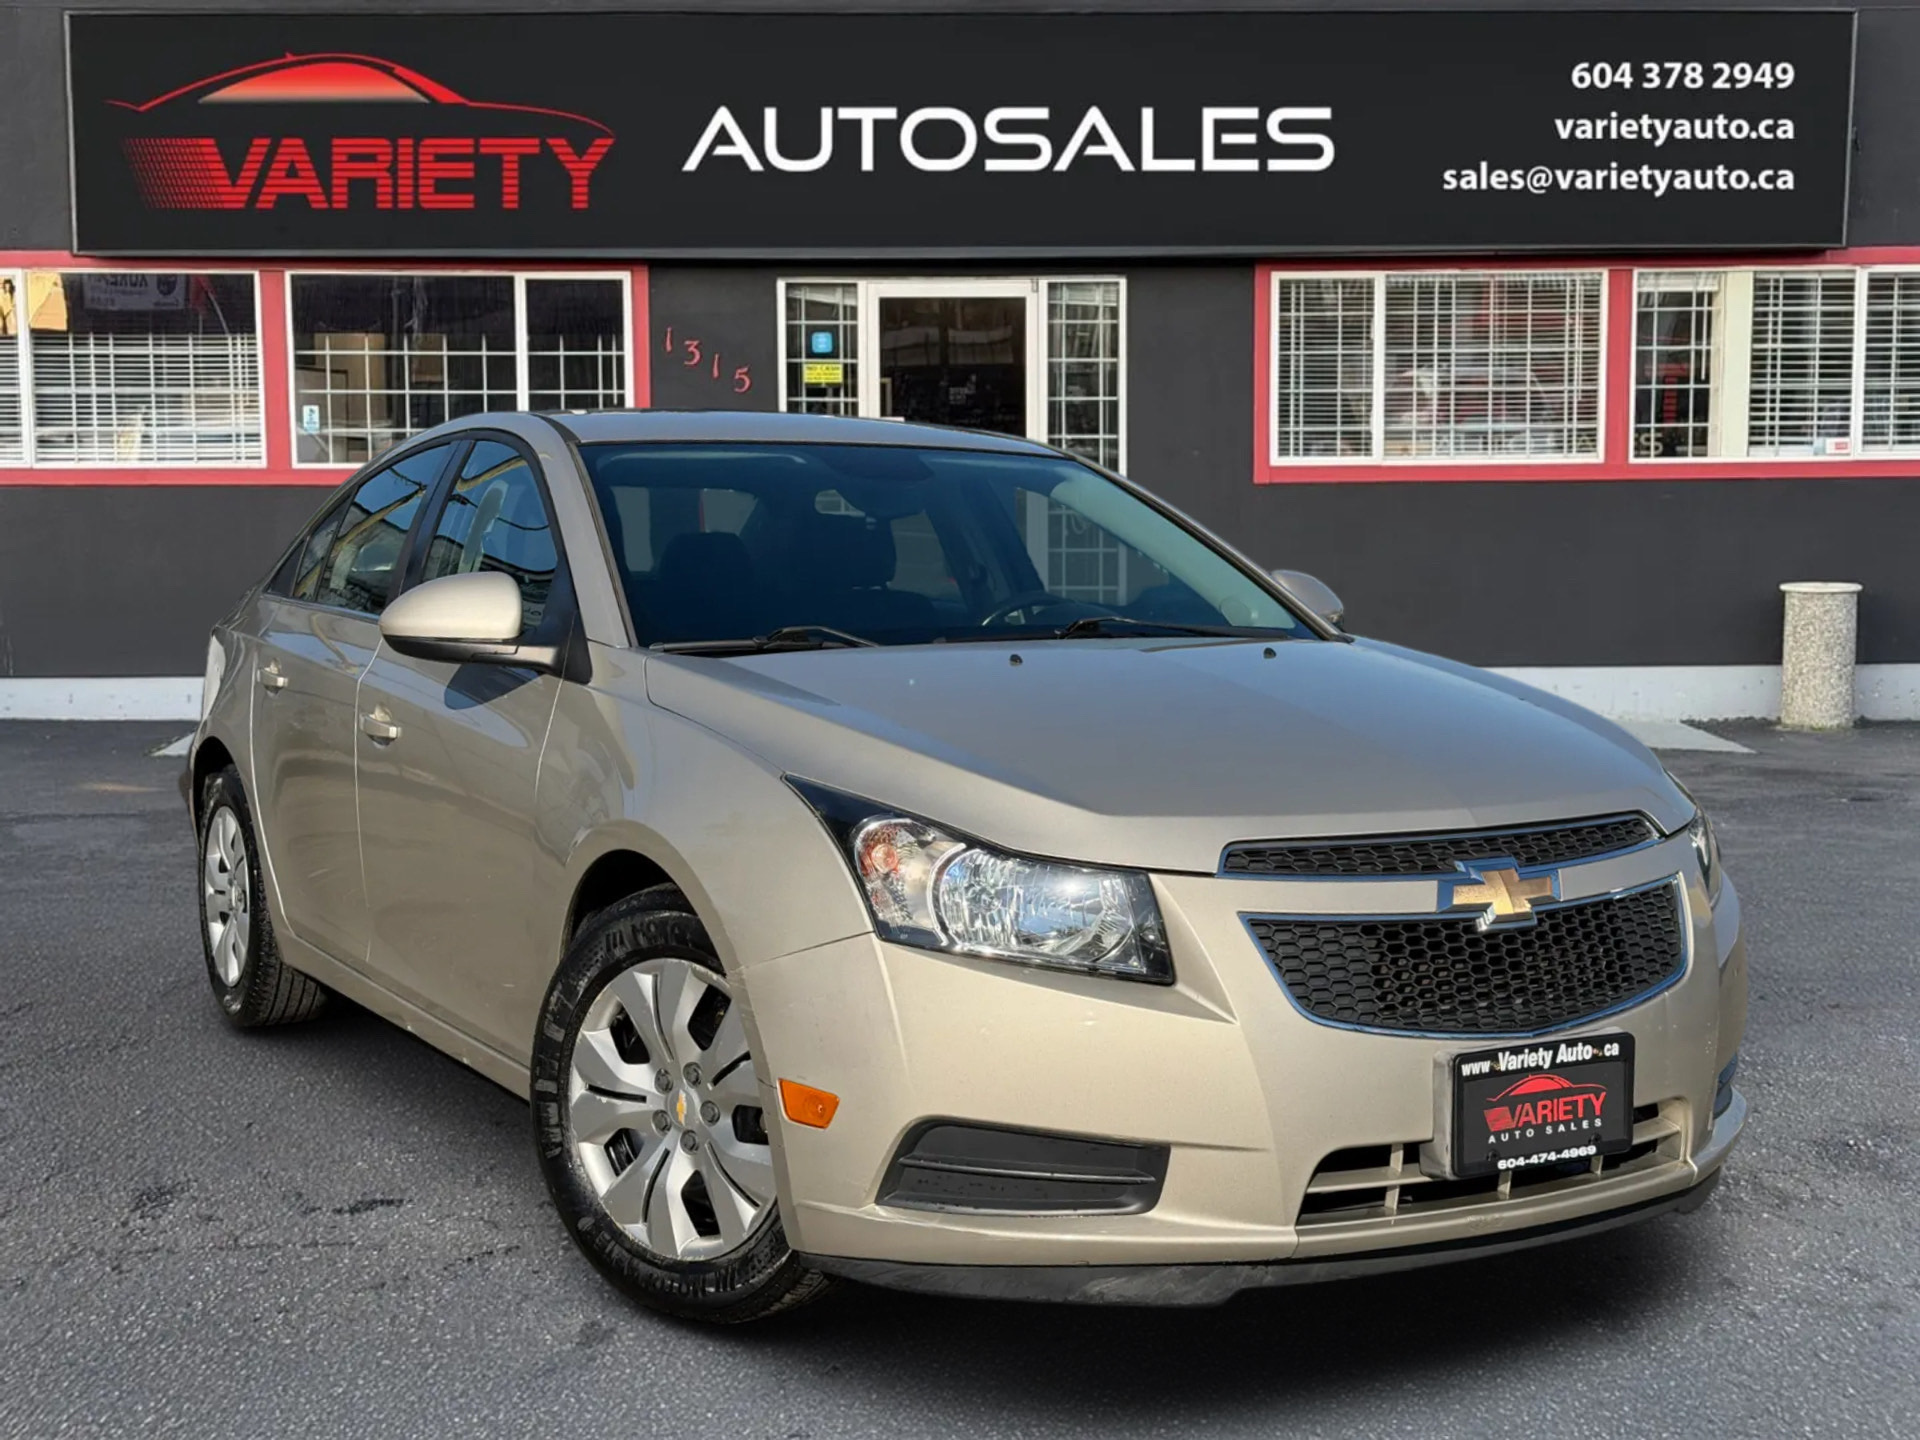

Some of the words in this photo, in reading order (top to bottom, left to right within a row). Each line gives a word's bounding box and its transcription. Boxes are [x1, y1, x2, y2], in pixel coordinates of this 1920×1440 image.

[1571, 61, 1633, 89] 604
[1643, 61, 1703, 89] 378
[1711, 61, 1795, 89] 2949
[681, 105, 1335, 172] AUTOSALES
[1554, 111, 1795, 147] varietyauto.ca
[122, 137, 615, 210] VARIETY
[1443, 161, 1795, 197] sales@varietyauto.ca
[1461, 1059, 1492, 1077] www
[1498, 1048, 1553, 1072] Variety
[1555, 1042, 1593, 1064] Auto
[1603, 1042, 1620, 1057] ca
[1483, 1091, 1607, 1133] VARIETY
[1488, 1128, 1535, 1144] AUTO
[1545, 1118, 1602, 1135] SALES
[1497, 1145, 1597, 1170] 604-474-4969
